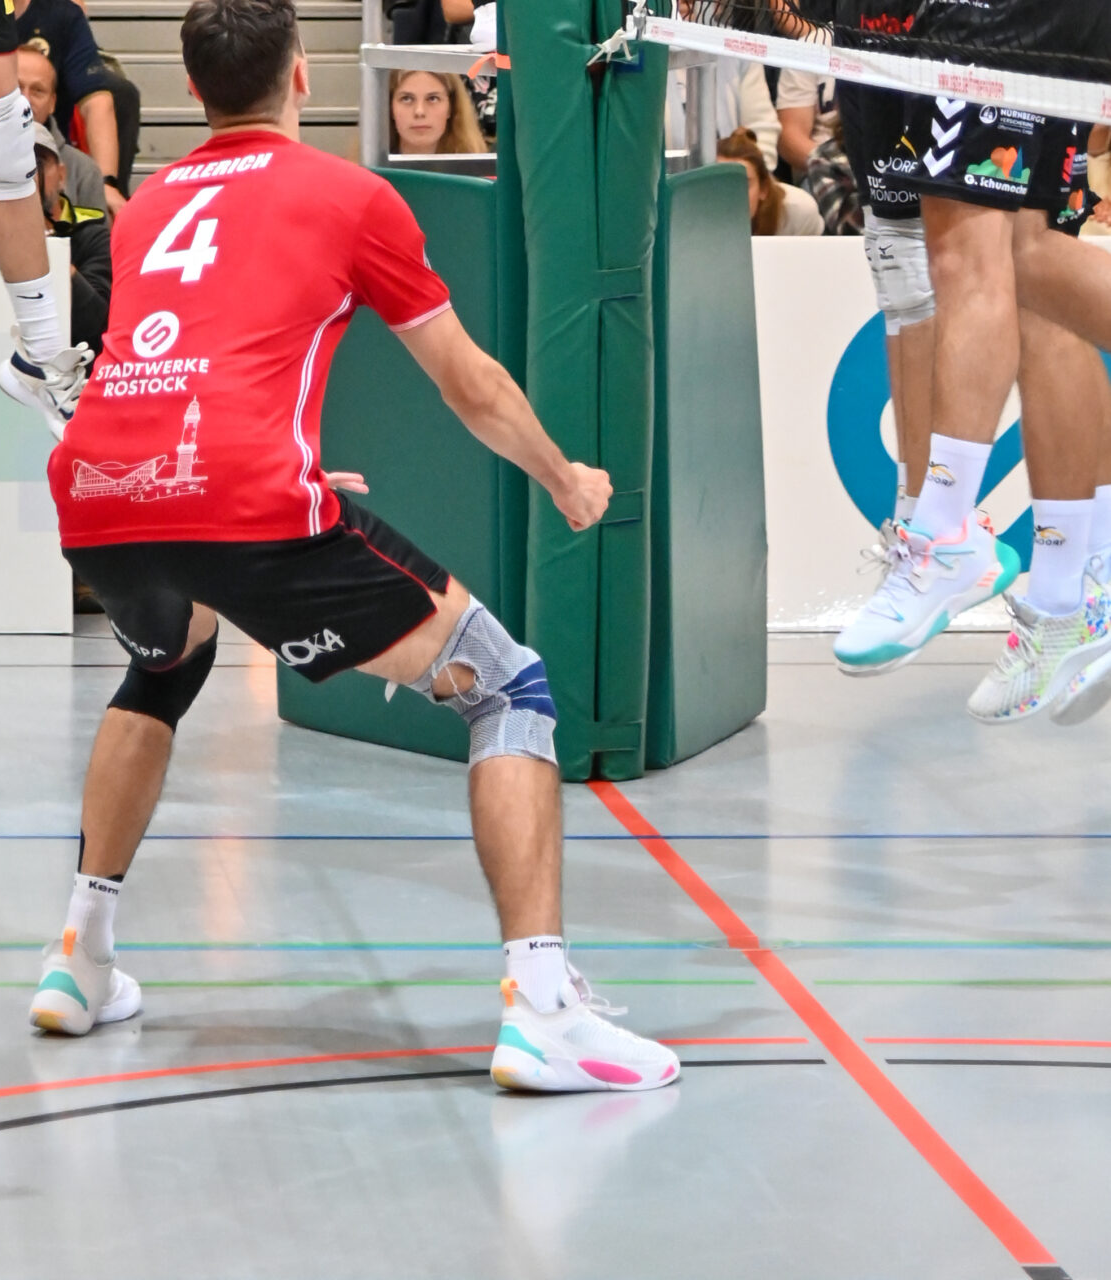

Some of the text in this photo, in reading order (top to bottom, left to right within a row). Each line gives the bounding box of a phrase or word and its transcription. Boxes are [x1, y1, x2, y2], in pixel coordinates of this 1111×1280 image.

[164, 152, 273, 184] ULLERICH
[139, 184, 225, 283] 4
[95, 358, 209, 380] STADTWERKE
[103, 375, 188, 397] ROSTOCK
[271, 628, 346, 666] LOKA
